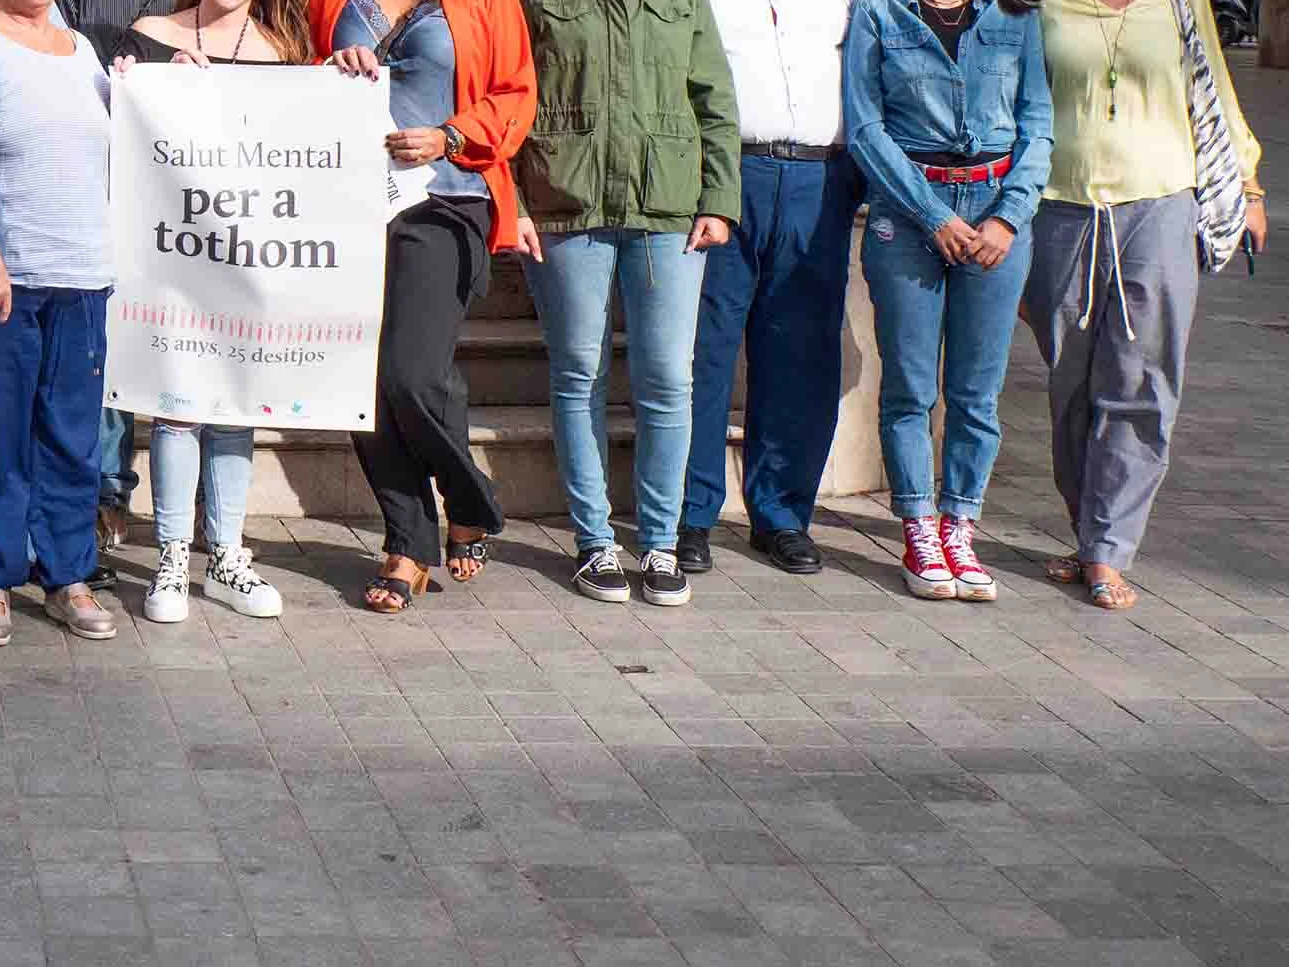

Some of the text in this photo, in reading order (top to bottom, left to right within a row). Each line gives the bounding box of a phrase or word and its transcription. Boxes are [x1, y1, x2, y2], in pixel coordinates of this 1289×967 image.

[153, 140, 342, 169] Salut Mental
[181, 186, 299, 223] per a
[154, 220, 340, 268] tothom
[150, 335, 326, 366] 25 anys, 25 desitjos
